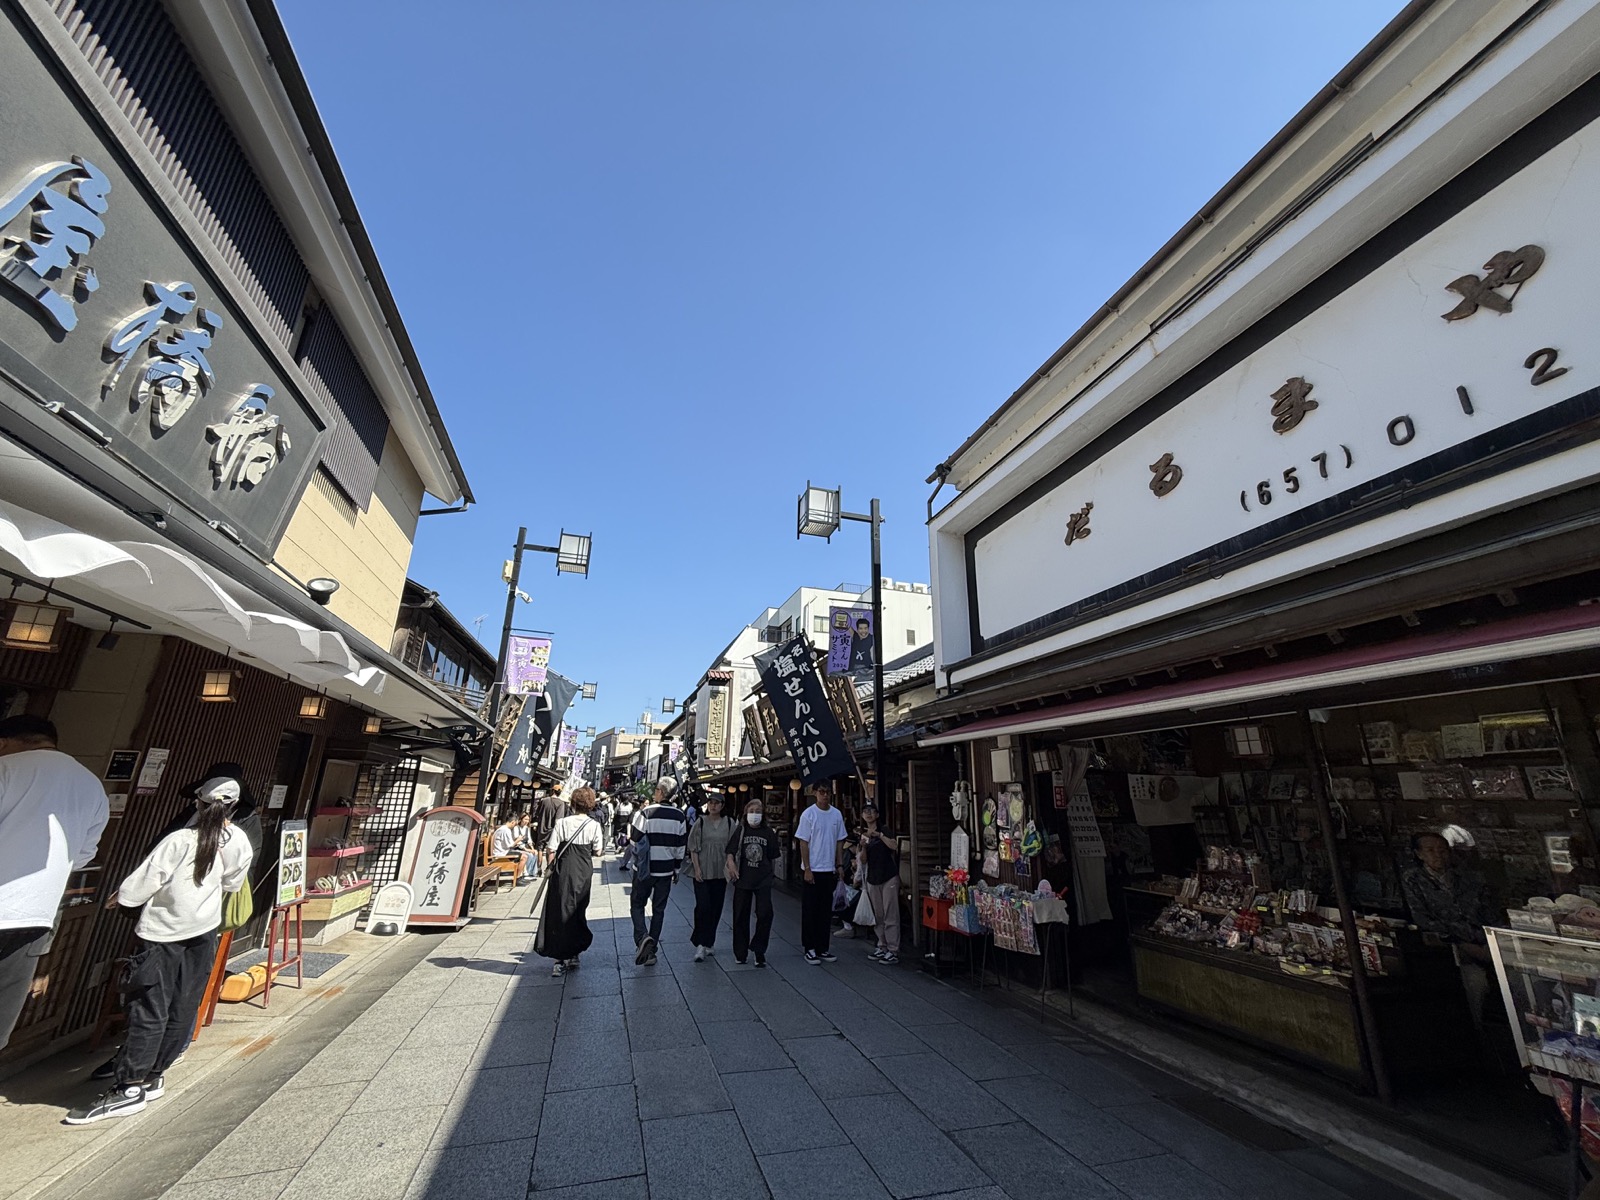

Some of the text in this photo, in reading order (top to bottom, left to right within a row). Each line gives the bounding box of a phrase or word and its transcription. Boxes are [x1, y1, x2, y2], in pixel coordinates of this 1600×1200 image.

[1065, 244, 1546, 546] だるまや
[1239, 442, 1354, 513] (657)
[791, 643, 811, 676] 名代
[831, 635, 840, 662] サミット
[839, 634, 851, 661] 寅さん
[773, 654, 828, 763] 塩せんべい
[744, 836, 768, 846] REGENTS
[419, 838, 457, 908] 船橋屋
